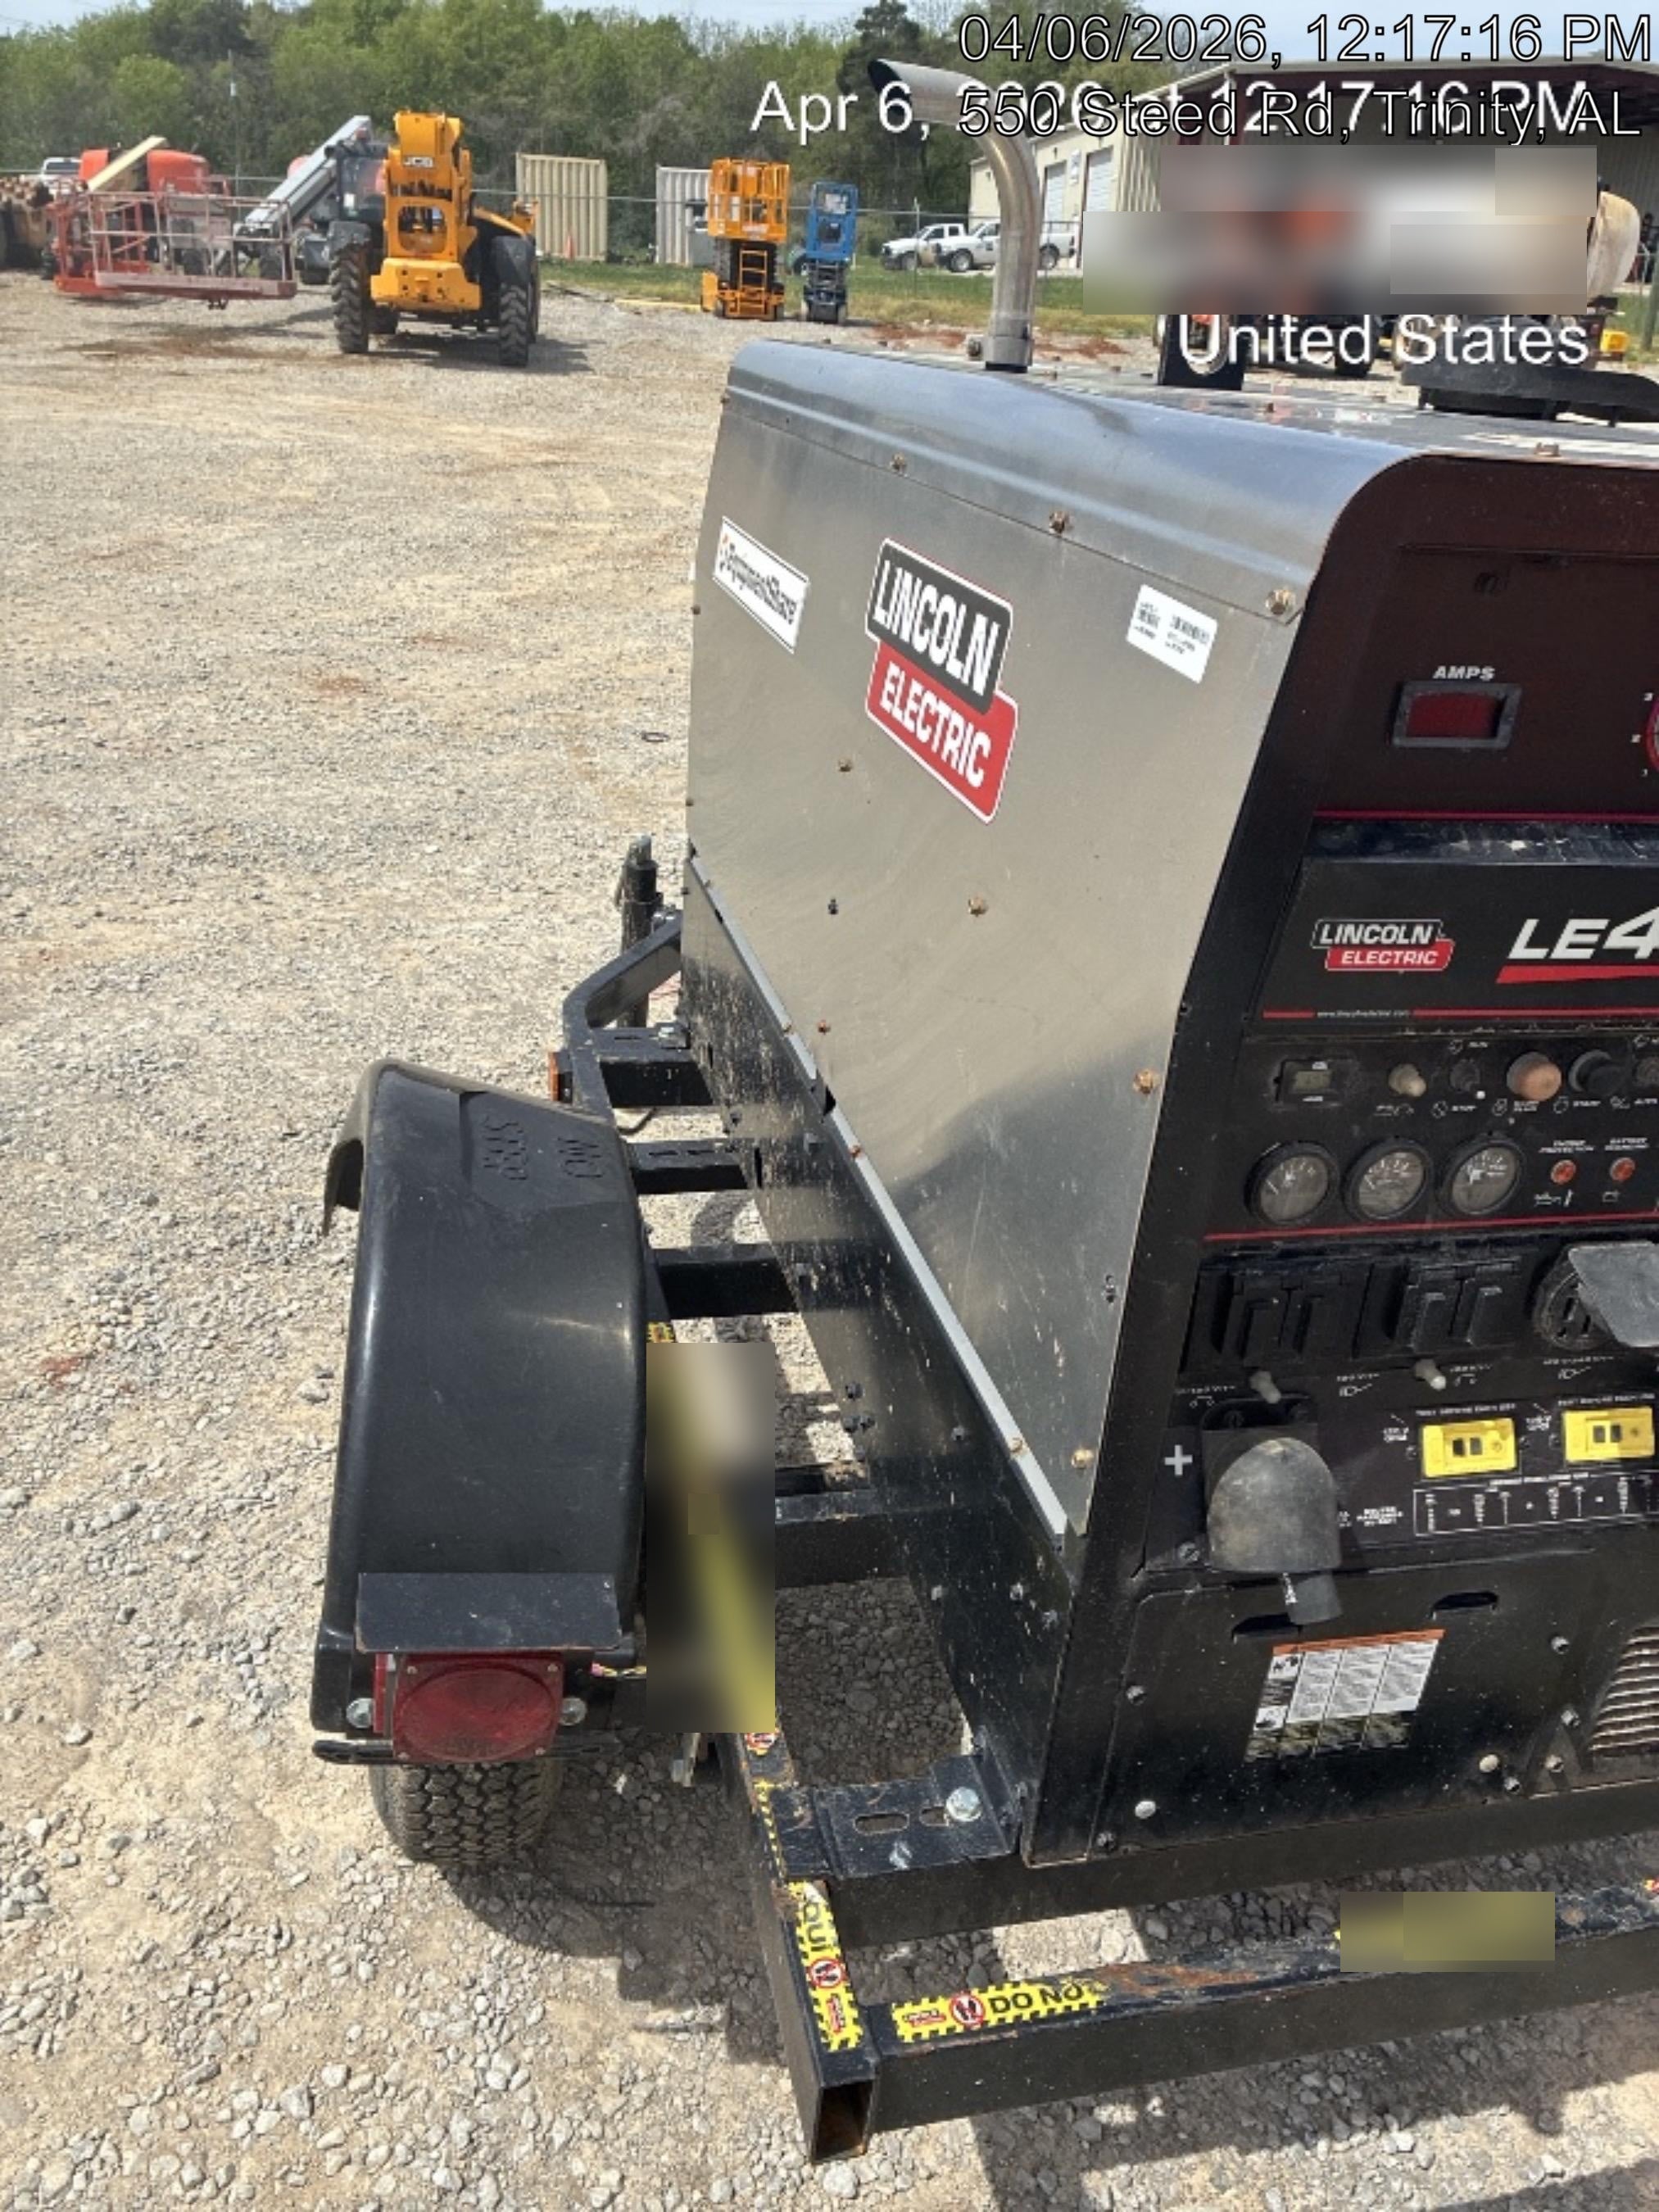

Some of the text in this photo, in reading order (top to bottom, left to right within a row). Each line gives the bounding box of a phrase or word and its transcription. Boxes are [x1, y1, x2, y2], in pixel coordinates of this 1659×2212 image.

[873, 560, 1001, 697] LINCOLN
[1432, 665, 1495, 682] AMPS
[879, 661, 991, 788] ELECTRIC
[1320, 923, 1434, 945] LINCOLN
[1341, 950, 1439, 965] ELECTRIC
[804, 1902, 834, 1951] QUI
[990, 1983, 1085, 2014] DO NO
